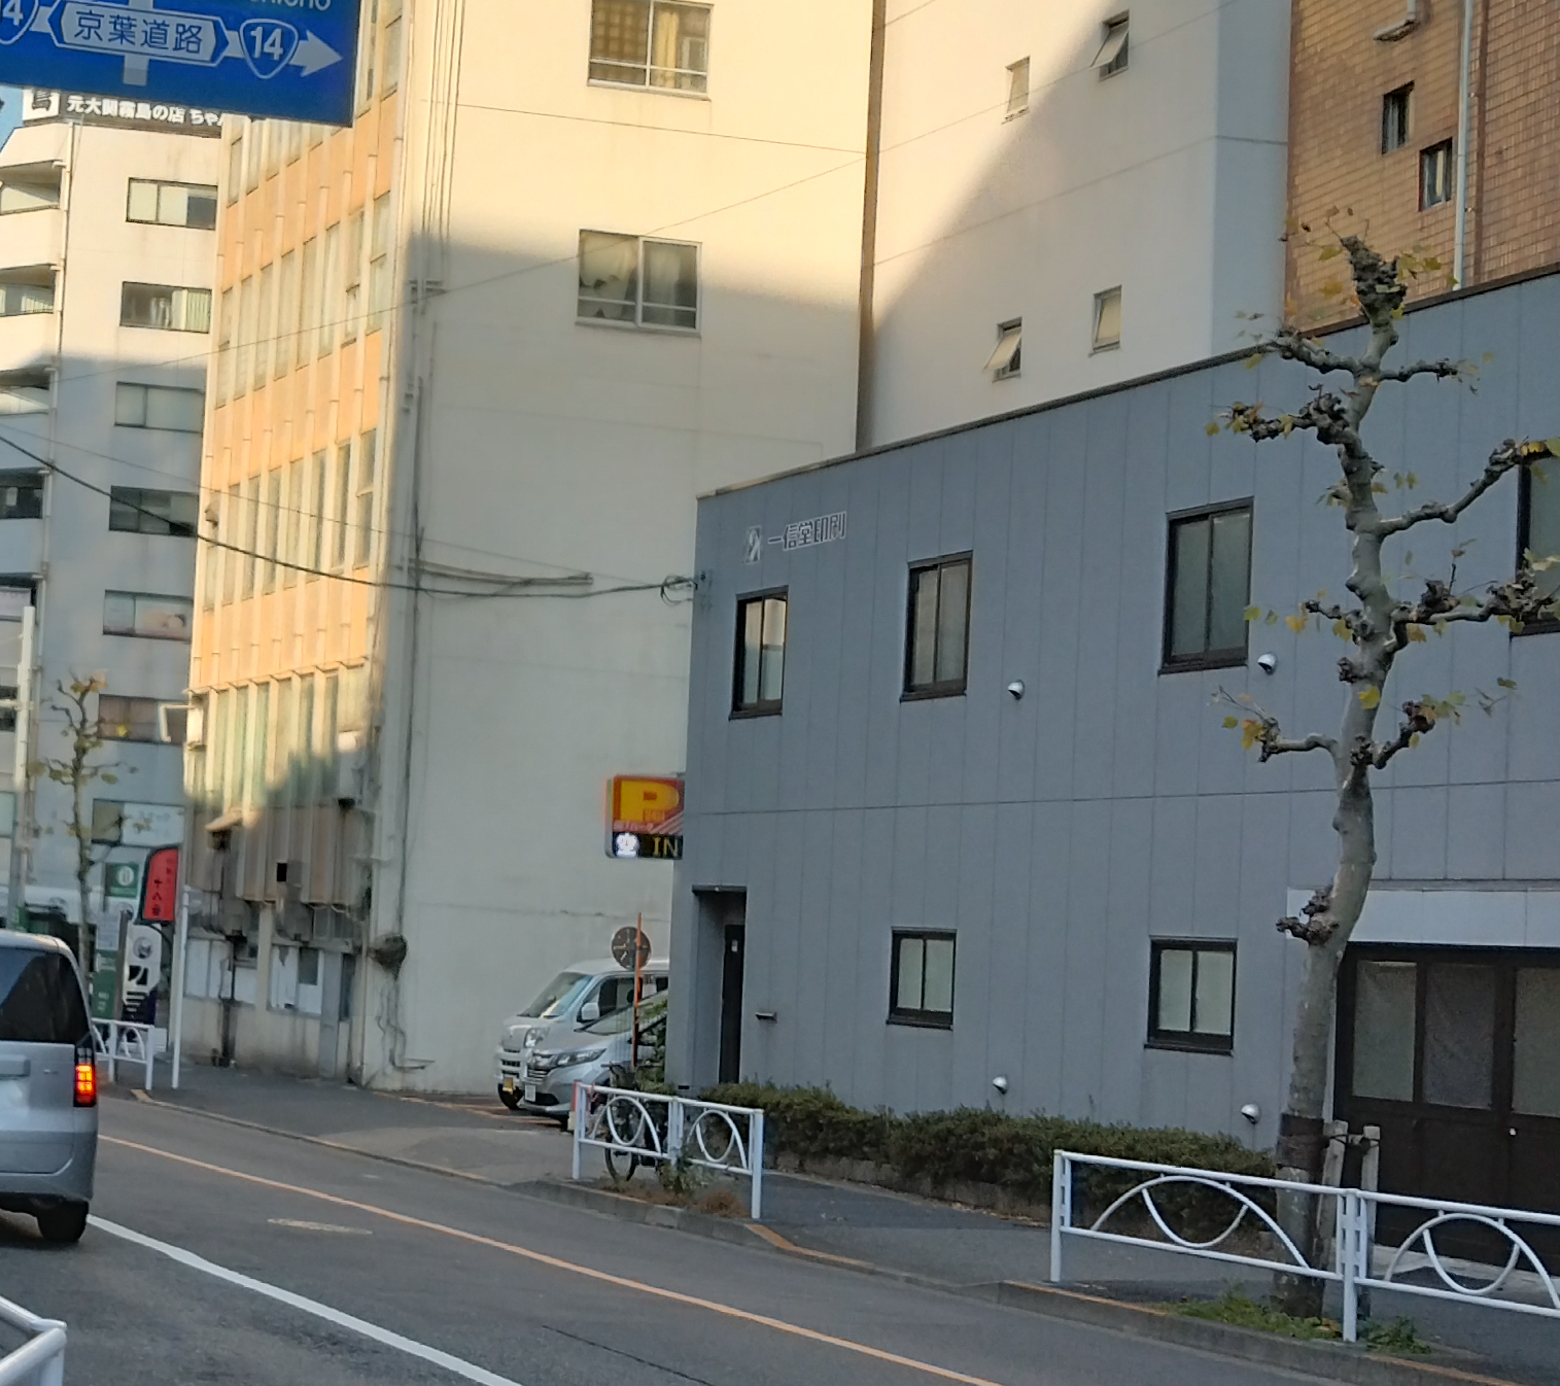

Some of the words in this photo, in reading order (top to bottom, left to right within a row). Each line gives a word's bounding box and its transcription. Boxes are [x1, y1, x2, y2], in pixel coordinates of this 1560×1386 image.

[74, 10, 205, 55] 京葉道路
[250, 26, 285, 62] 14
[768, 511, 847, 551] 一信堂印刷
